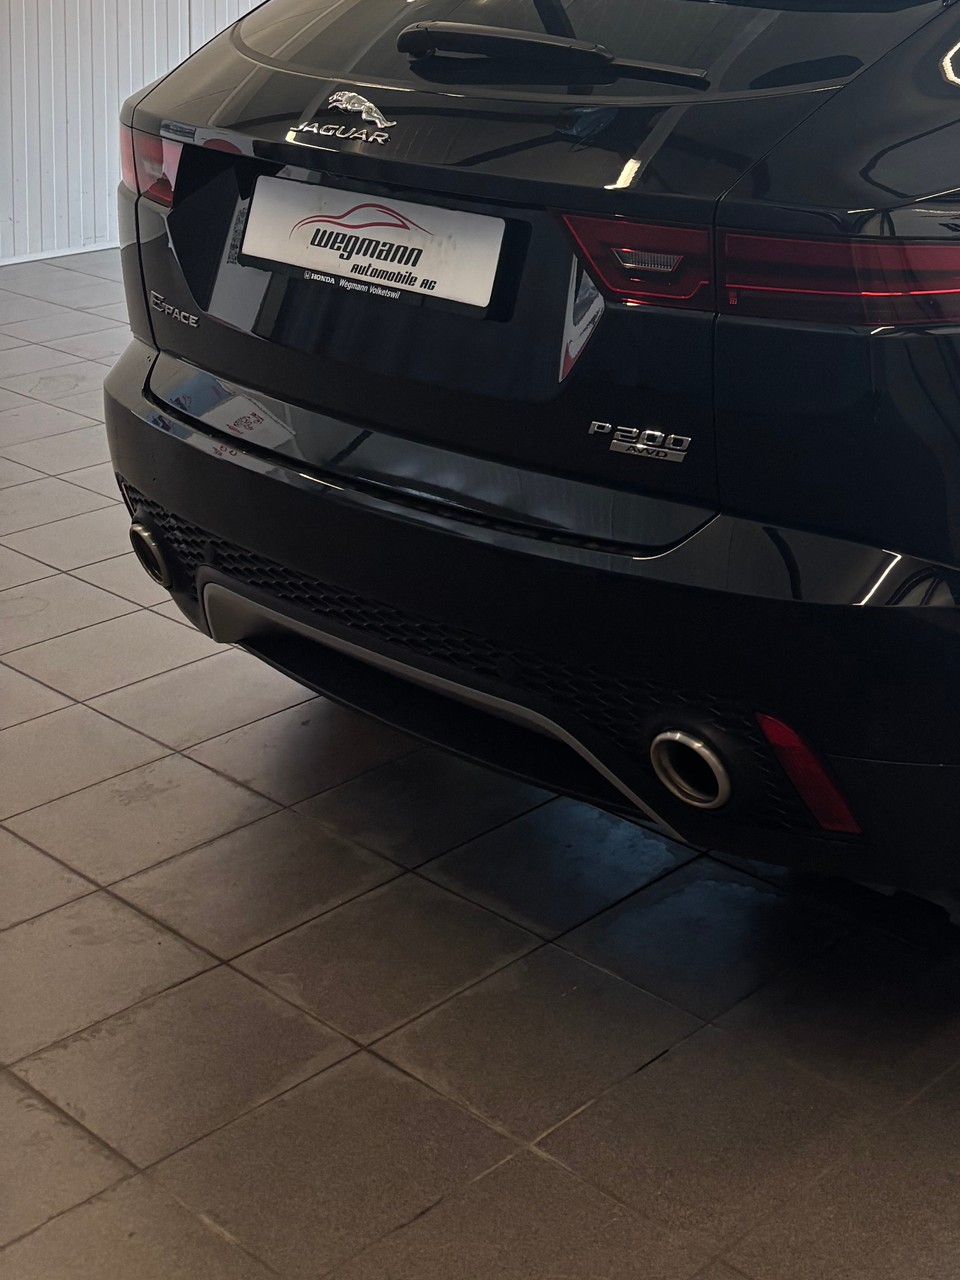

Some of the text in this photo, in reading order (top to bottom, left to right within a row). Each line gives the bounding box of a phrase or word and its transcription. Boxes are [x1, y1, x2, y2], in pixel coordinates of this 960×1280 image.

[290, 121, 389, 145] JAGUAR
[310, 228, 423, 267] wegmann
[310, 273, 401, 300] HONDA Wegmann Volketswil
[419, 278, 437, 291] AG
[588, 421, 692, 451] P200
[625, 446, 668, 458] AWD
